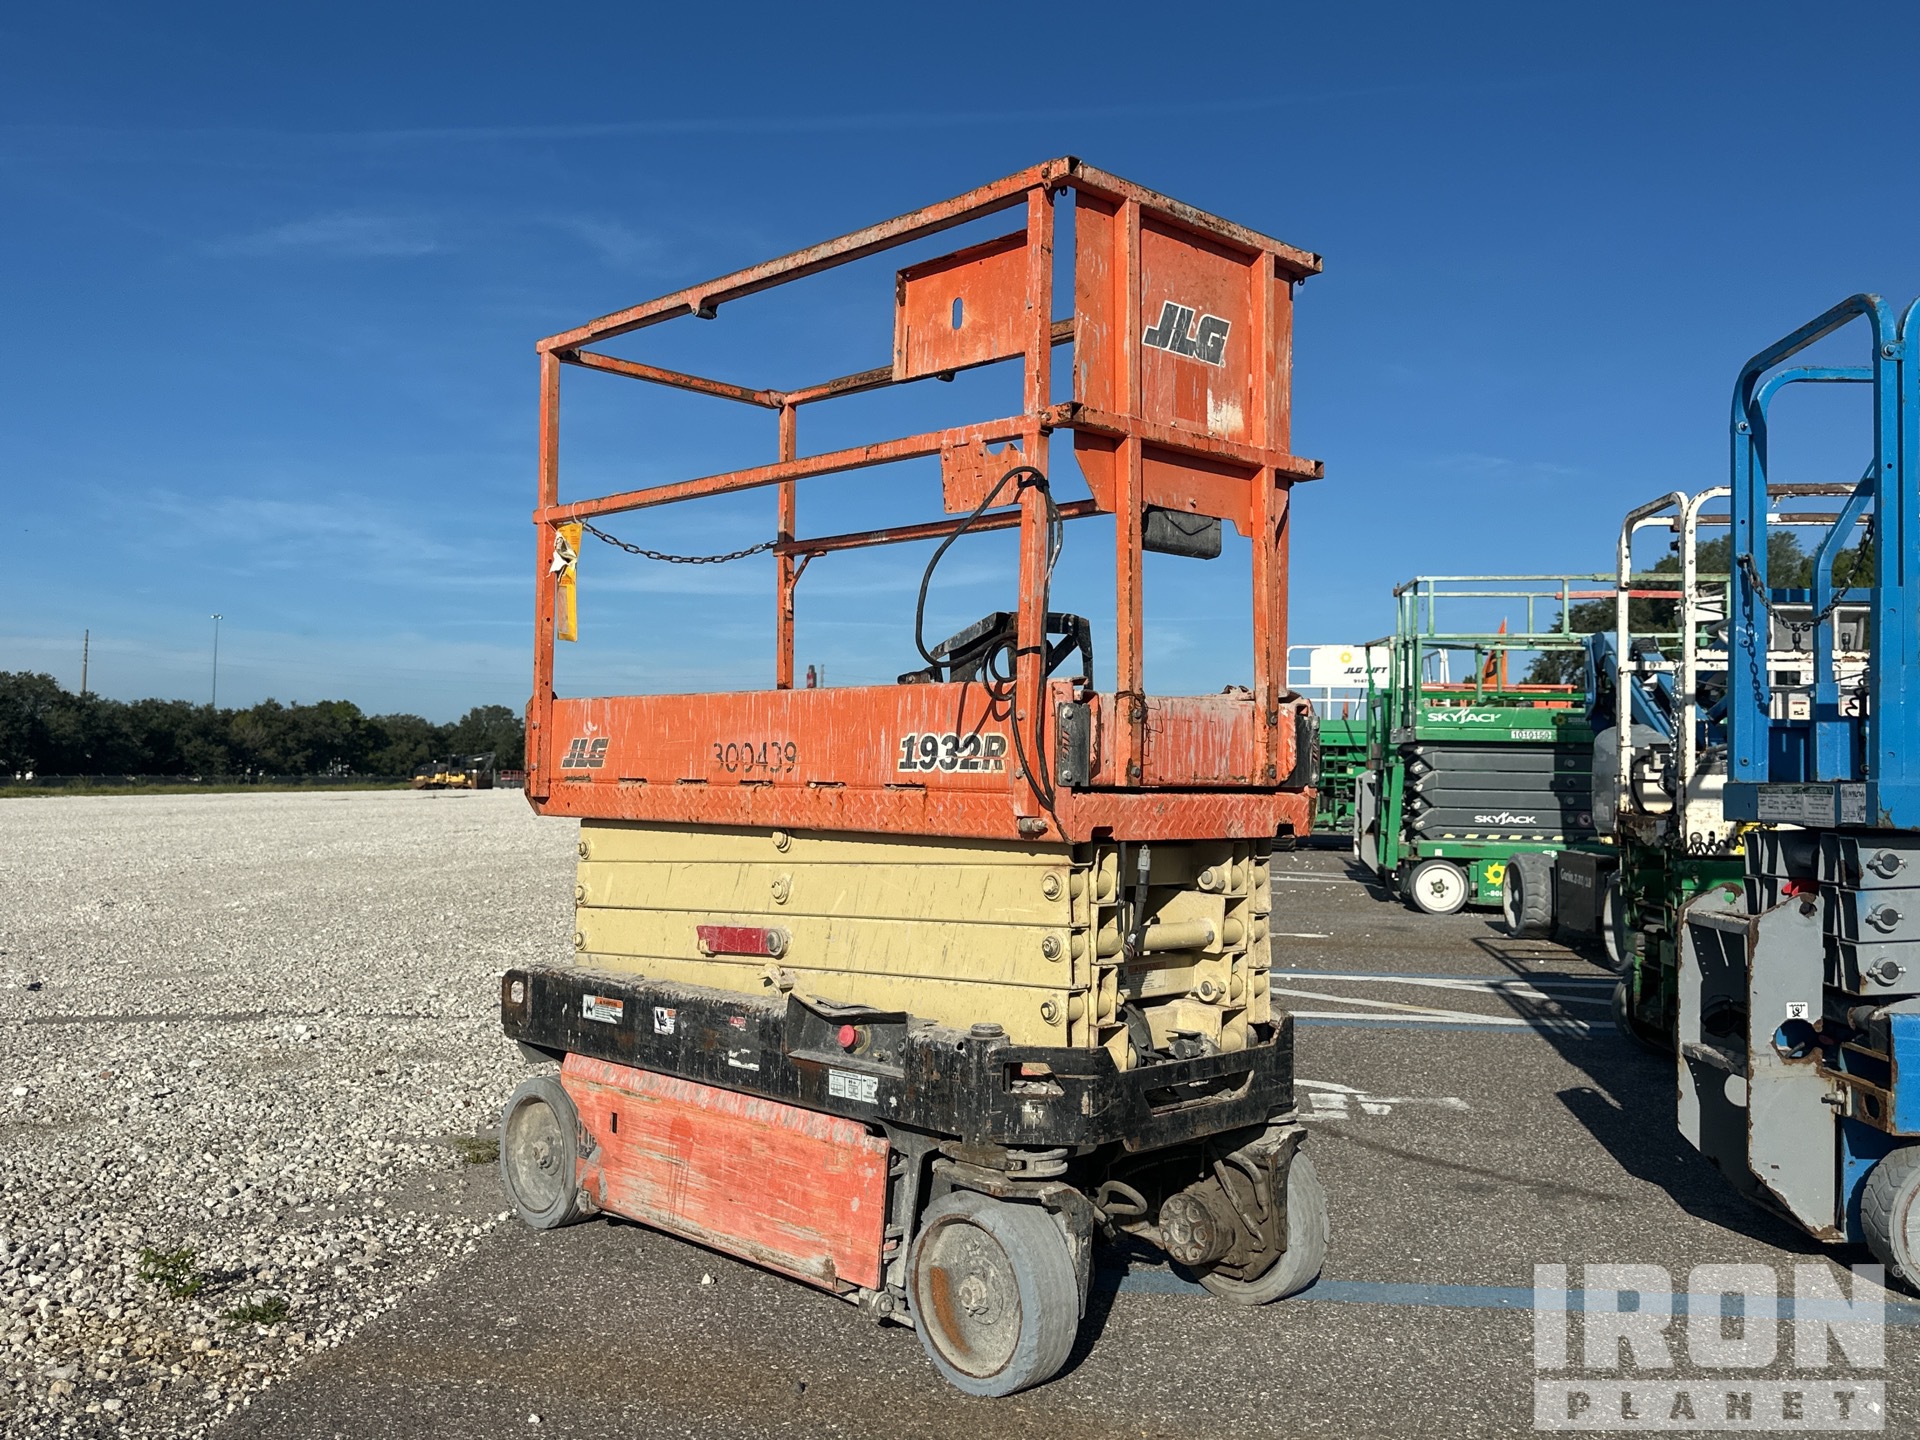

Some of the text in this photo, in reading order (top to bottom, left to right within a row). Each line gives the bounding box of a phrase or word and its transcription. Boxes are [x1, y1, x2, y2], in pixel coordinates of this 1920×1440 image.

[1142, 300, 1231, 366] JLG
[560, 737, 610, 769] JLG
[713, 741, 797, 774] 300439
[897, 732, 1009, 773] 1932R
[1474, 811, 1537, 825] SKYJACK
